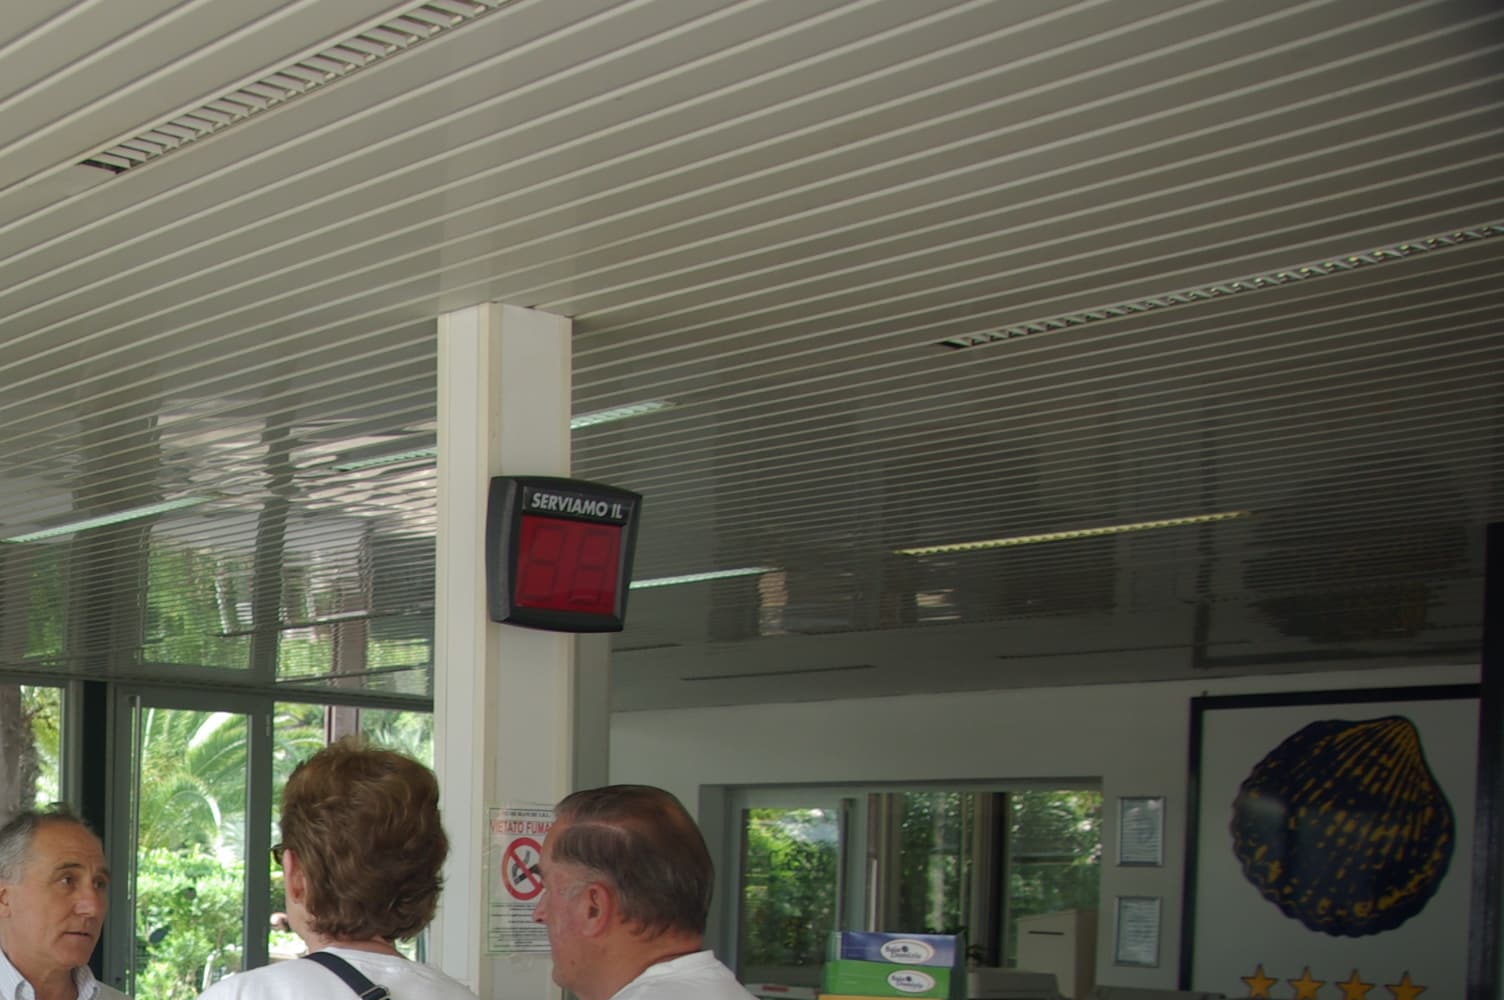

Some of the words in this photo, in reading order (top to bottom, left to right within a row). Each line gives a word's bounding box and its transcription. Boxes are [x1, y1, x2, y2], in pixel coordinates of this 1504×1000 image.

[531, 492, 608, 517] SERVIAMO
[611, 503, 623, 519] IL
[491, 820, 524, 833] VIETATO
